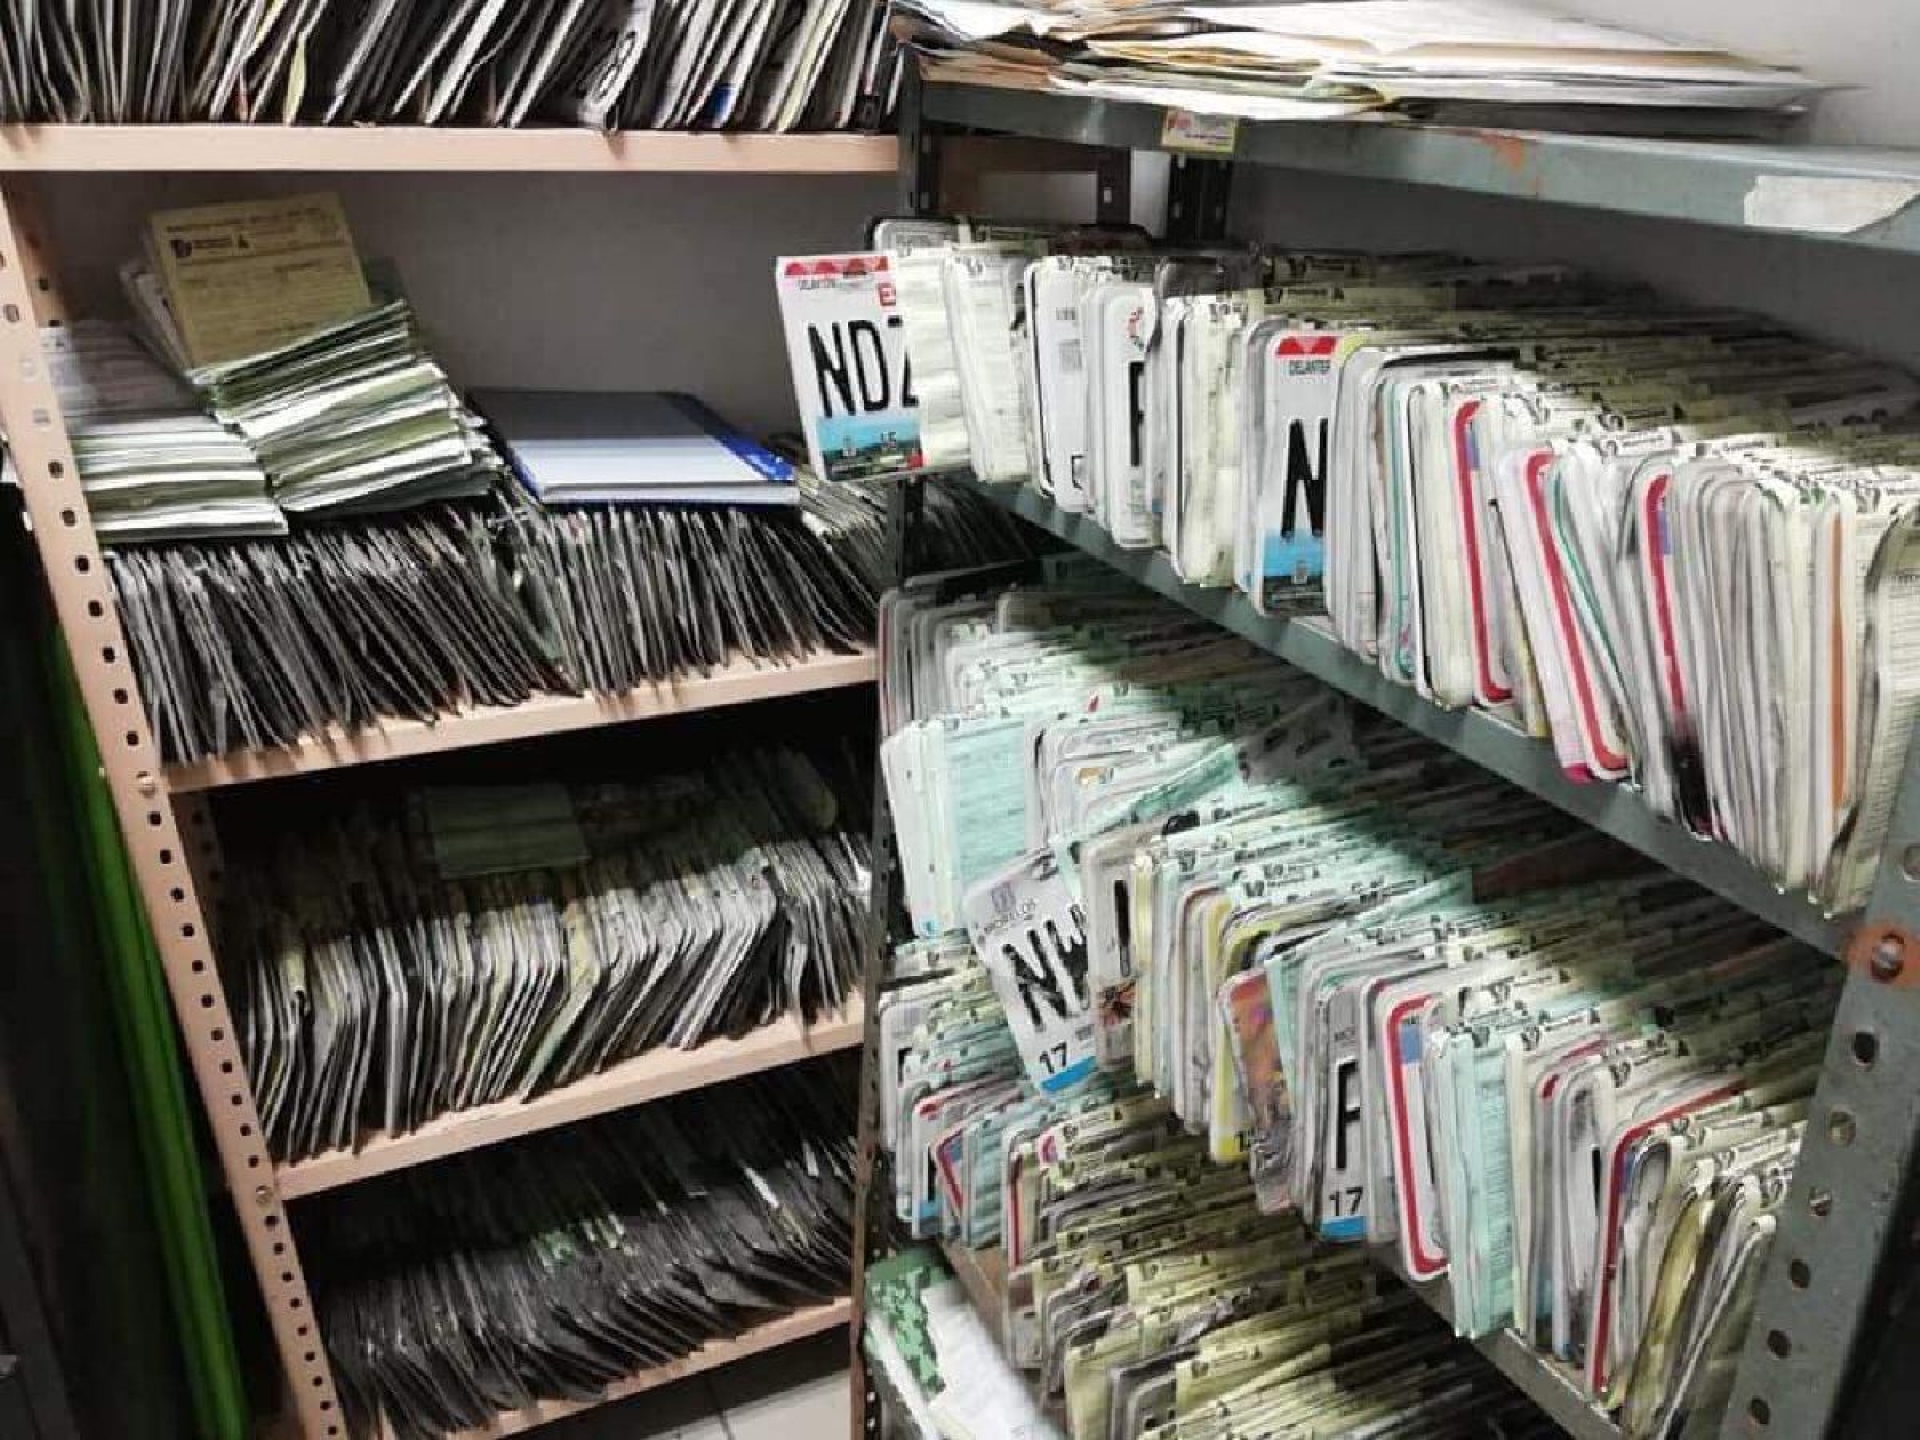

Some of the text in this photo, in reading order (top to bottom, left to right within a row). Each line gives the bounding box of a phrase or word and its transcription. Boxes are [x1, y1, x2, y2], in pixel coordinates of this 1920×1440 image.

[1281, 418, 1329, 540] N
[1040, 1042, 1067, 1073] 17
[1329, 1186, 1363, 1217] 17
